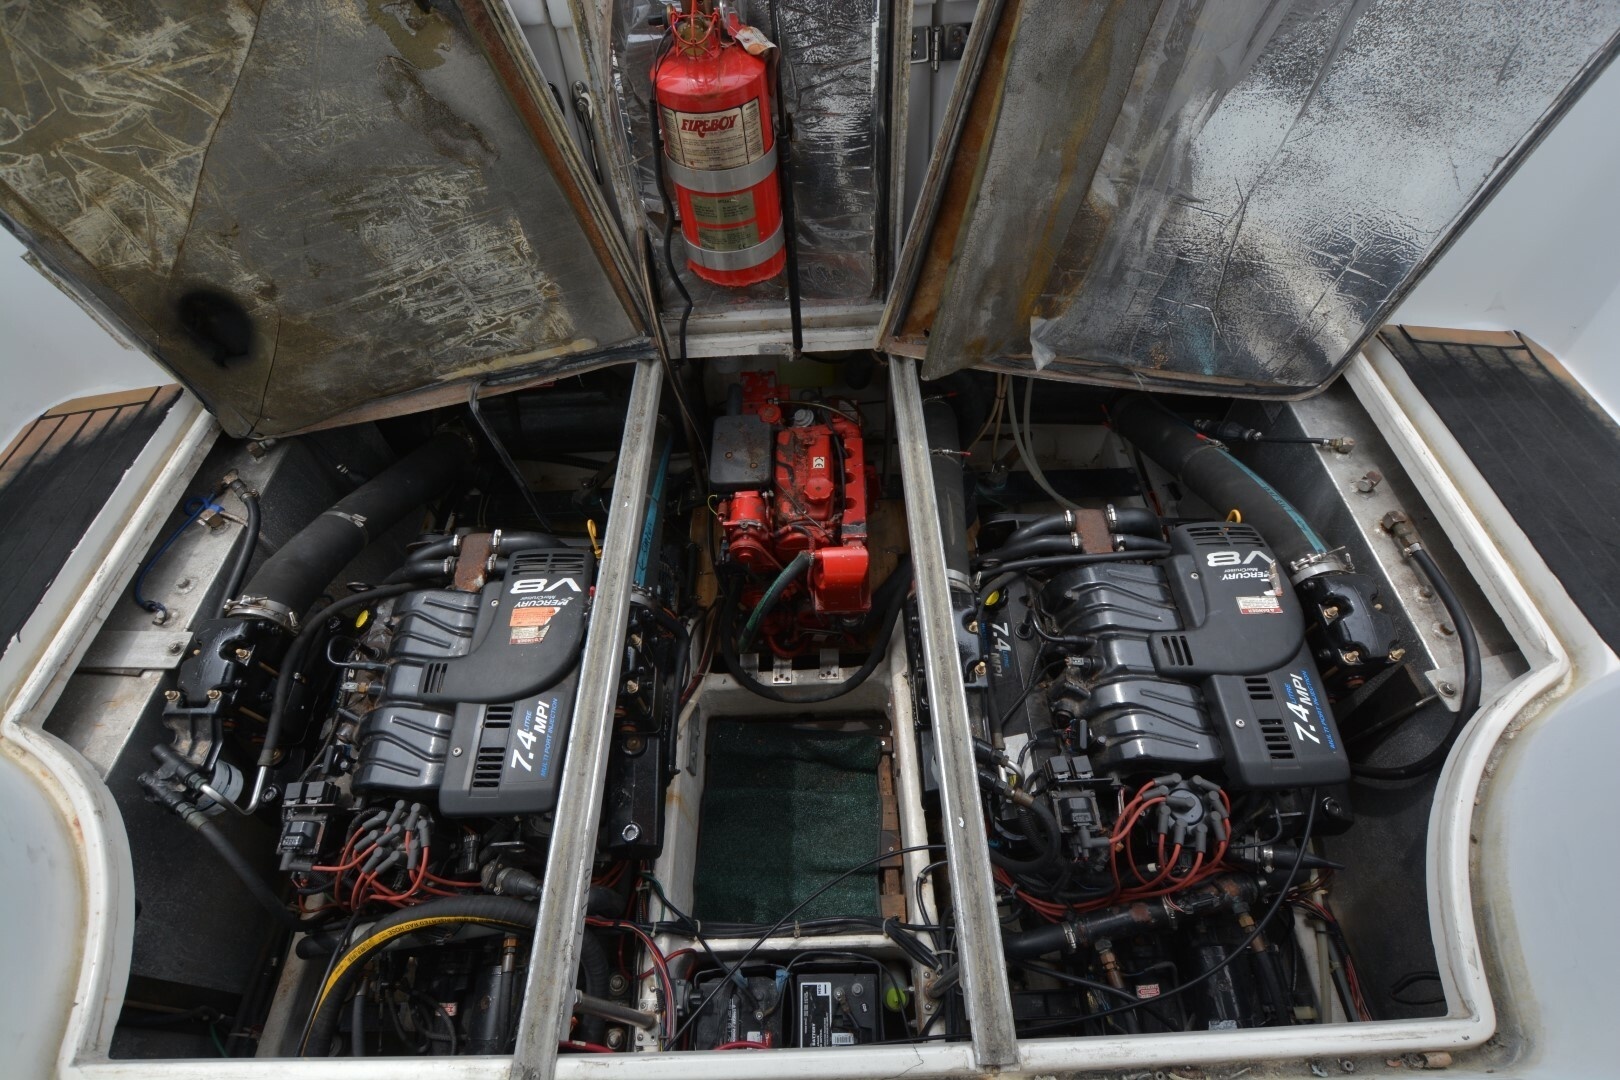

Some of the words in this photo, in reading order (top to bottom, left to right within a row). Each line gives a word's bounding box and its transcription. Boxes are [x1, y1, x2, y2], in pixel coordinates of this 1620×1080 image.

[681, 114, 739, 138] FIREBOY
[1207, 550, 1273, 567] V8
[509, 577, 582, 595] V8
[514, 599, 569, 608] MERCURY
[991, 622, 1011, 651] 7.4
[991, 652, 1003, 677] MPI
[1285, 683, 1297, 704] LITRE
[1290, 673, 1313, 706] MPI
[1301, 670, 1319, 707] INJECTION
[523, 710, 532, 731] LITRE
[534, 701, 550, 734] MPI
[547, 698, 558, 733] INJECTION
[1286, 701, 1320, 744] 7.4
[1317, 708, 1326, 726] PORT
[544, 735, 552, 754] PORT
[1323, 725, 1336, 750] MULTI
[511, 729, 537, 772] 7.4
[540, 754, 550, 778] MULTI
[387, 926, 405, 937] HOSE
